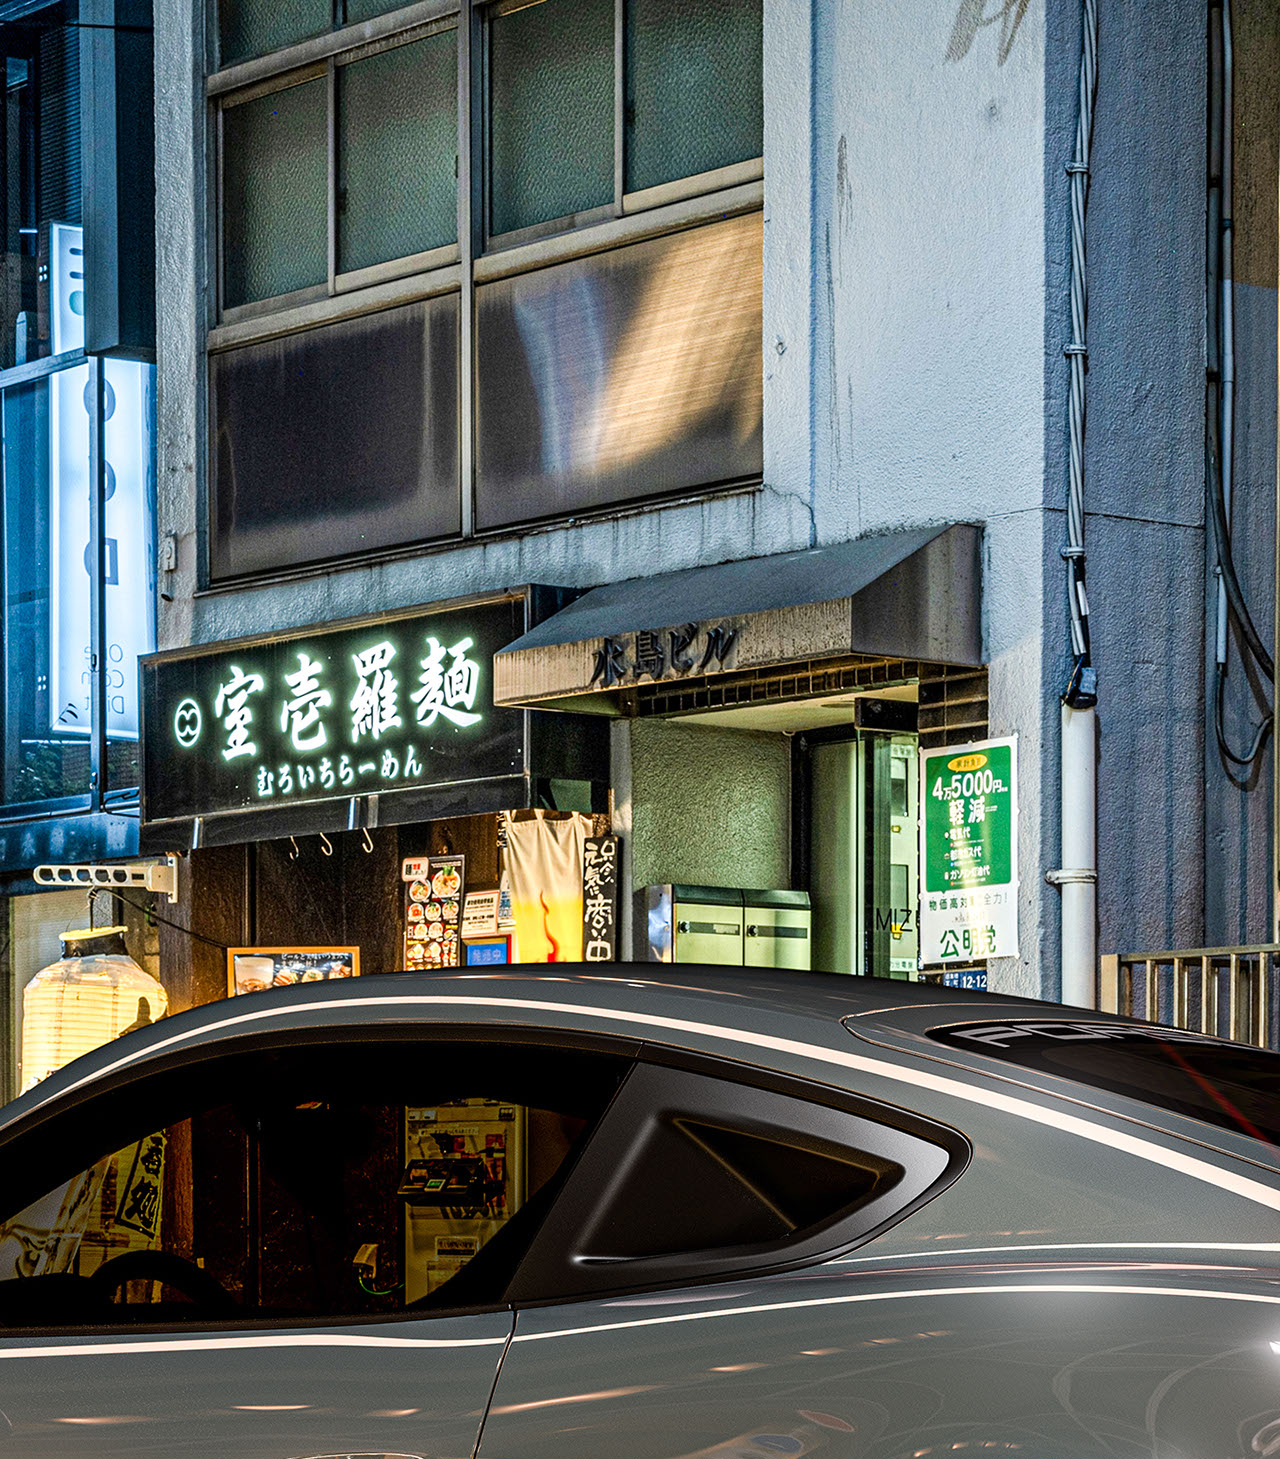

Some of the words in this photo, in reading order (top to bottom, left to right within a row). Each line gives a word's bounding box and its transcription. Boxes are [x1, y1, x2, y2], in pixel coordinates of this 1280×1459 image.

[590, 621, 737, 688] 水島ビル
[214, 636, 483, 761] 室壱羅麺
[256, 745, 423, 797] むろいちらーめん
[949, 795, 986, 826] 軽減
[876, 907, 921, 932] MIZ
[940, 924, 997, 958] 公明党
